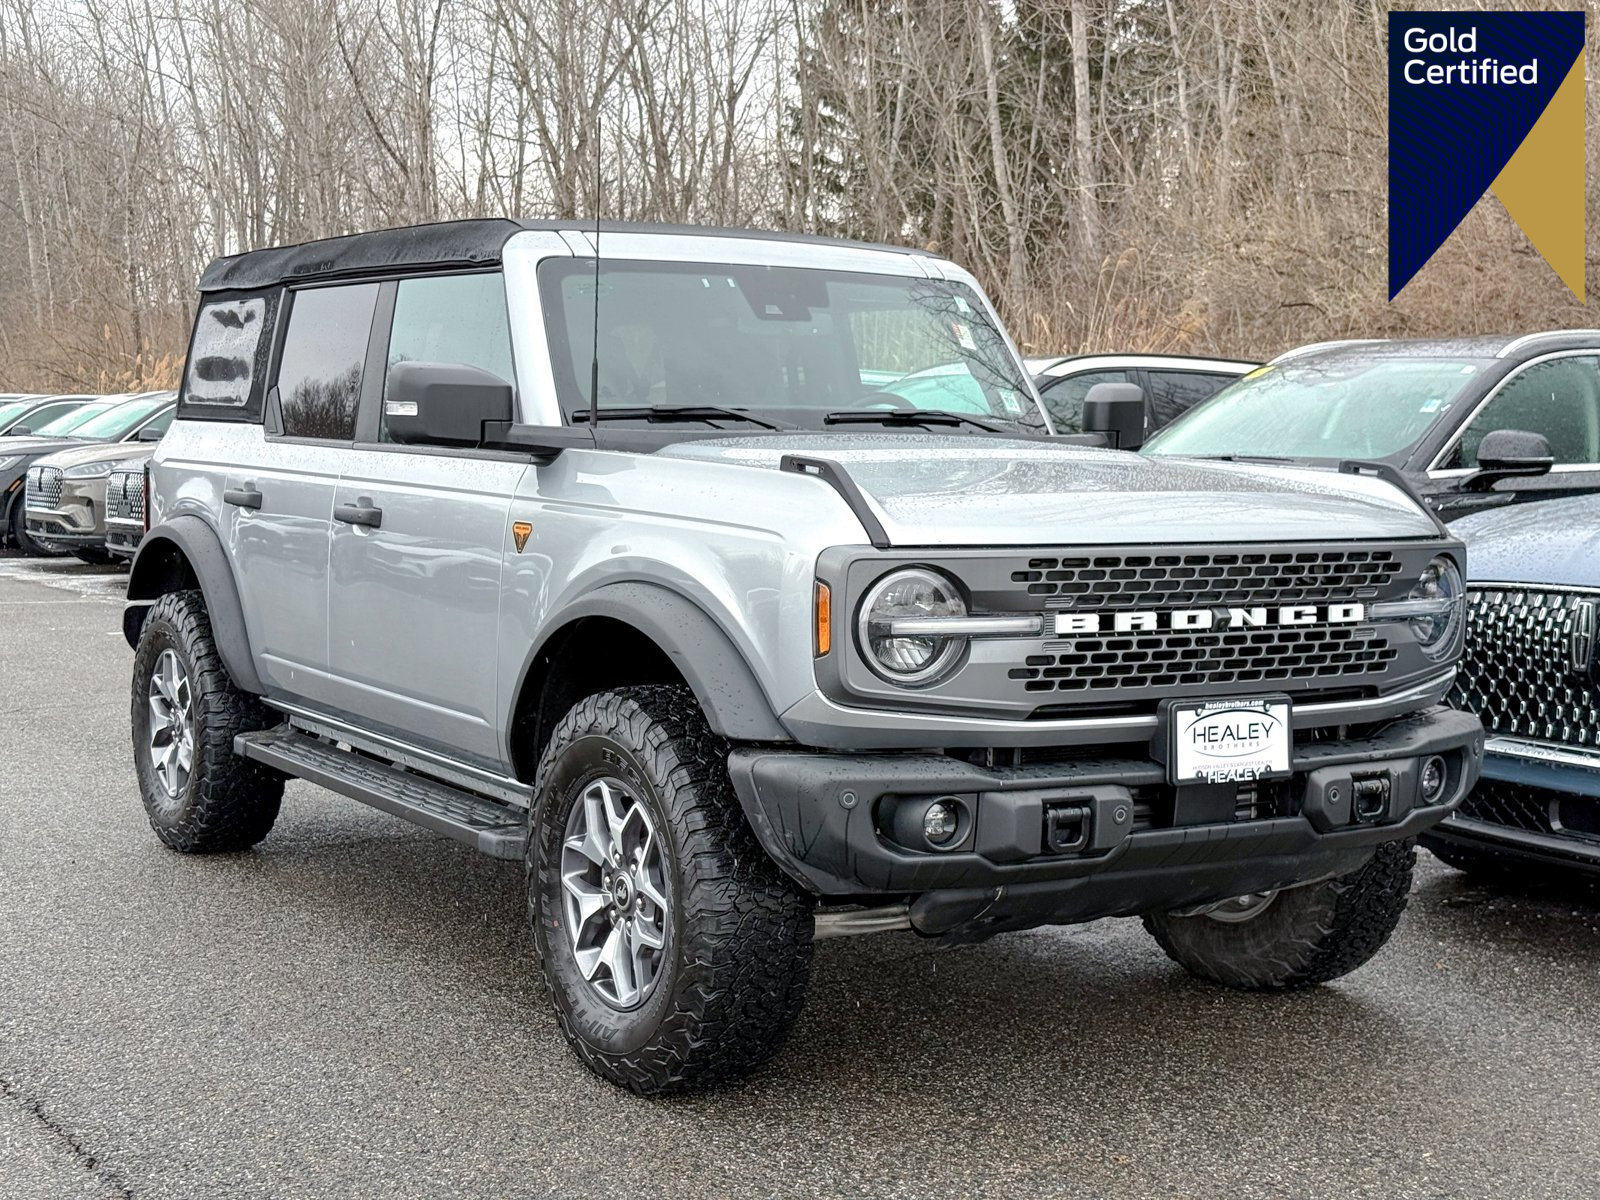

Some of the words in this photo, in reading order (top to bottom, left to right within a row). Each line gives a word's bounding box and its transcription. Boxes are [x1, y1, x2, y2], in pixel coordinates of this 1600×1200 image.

[1054, 603, 1365, 634] BRONCO
[1205, 700, 1264, 710] healeybrothers.com
[1193, 722, 1274, 744] HEALEY
[1204, 742, 1260, 751] BROTHERS
[1207, 767, 1262, 784] HEALEY
